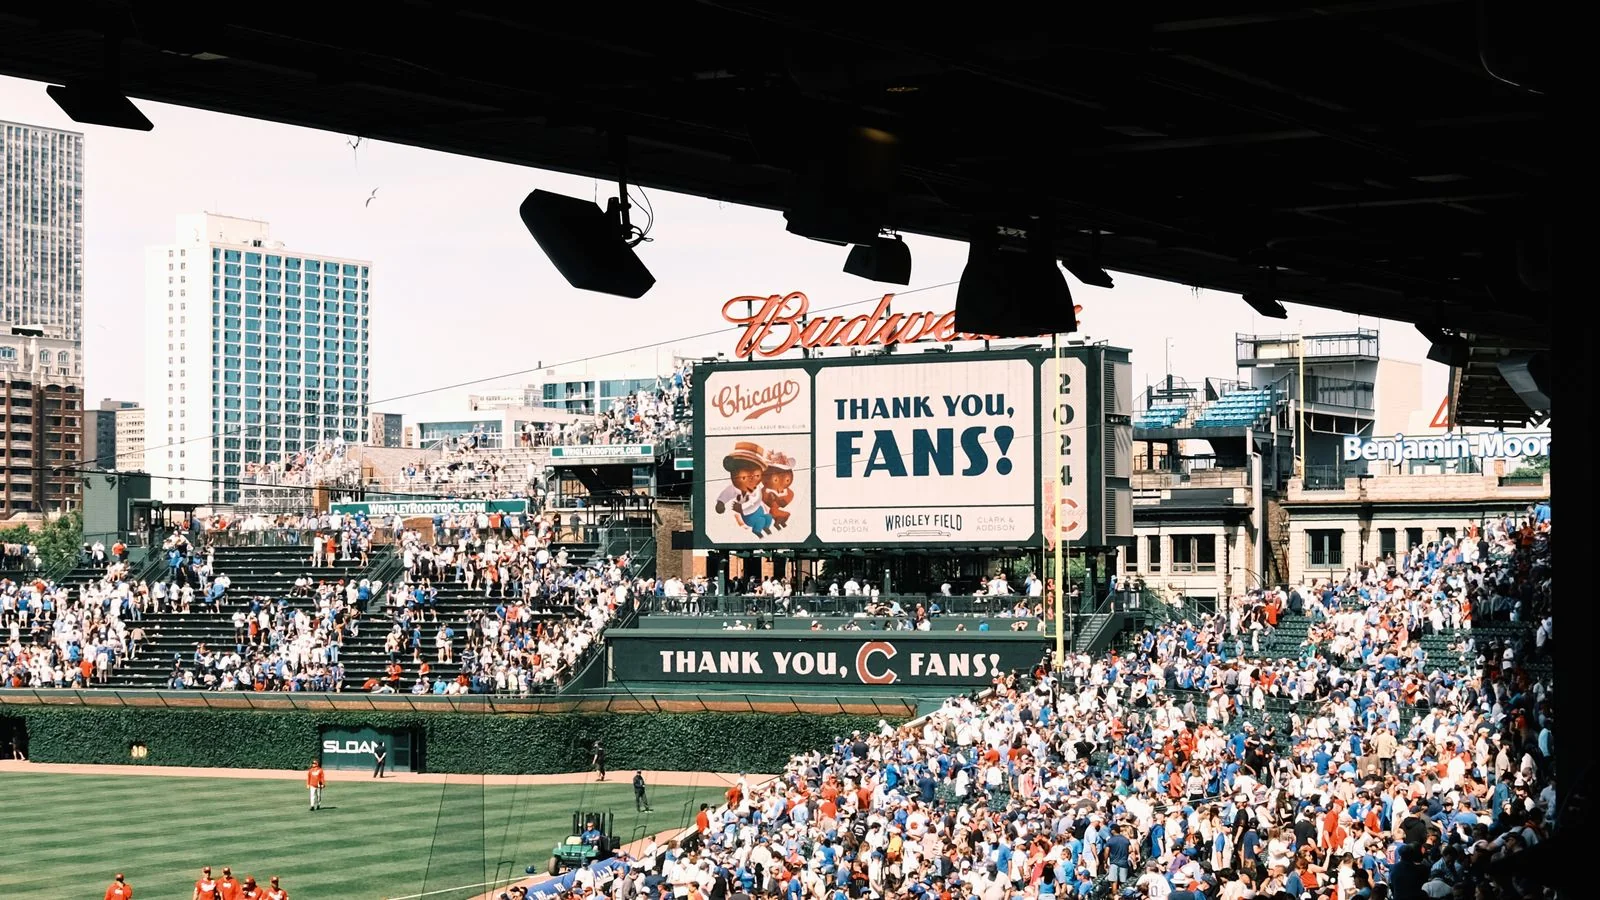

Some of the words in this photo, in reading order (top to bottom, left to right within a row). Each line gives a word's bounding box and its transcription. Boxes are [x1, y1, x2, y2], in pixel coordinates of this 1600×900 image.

[721, 291, 1083, 358] Budwe
[711, 379, 800, 421] Chicago
[834, 396, 935, 420] THANK
[943, 393, 1015, 418] YOU,
[564, 446, 642, 456] WRIGLEYROOFTOPS.COM
[835, 425, 1015, 478] FANS!
[1344, 432, 1470, 468] Benjamin
[1479, 431, 1551, 458] Moor
[368, 502, 486, 515] WRIGLEYROOFTOPS.COM
[977, 516, 1006, 524] CLARK
[885, 514, 930, 532] WRIGLEY
[934, 514, 962, 531] FIELD
[976, 524, 1016, 532] ADDISON
[660, 650, 763, 674] THANK
[773, 651, 848, 679] YOU,
[910, 653, 1001, 677] FANS!
